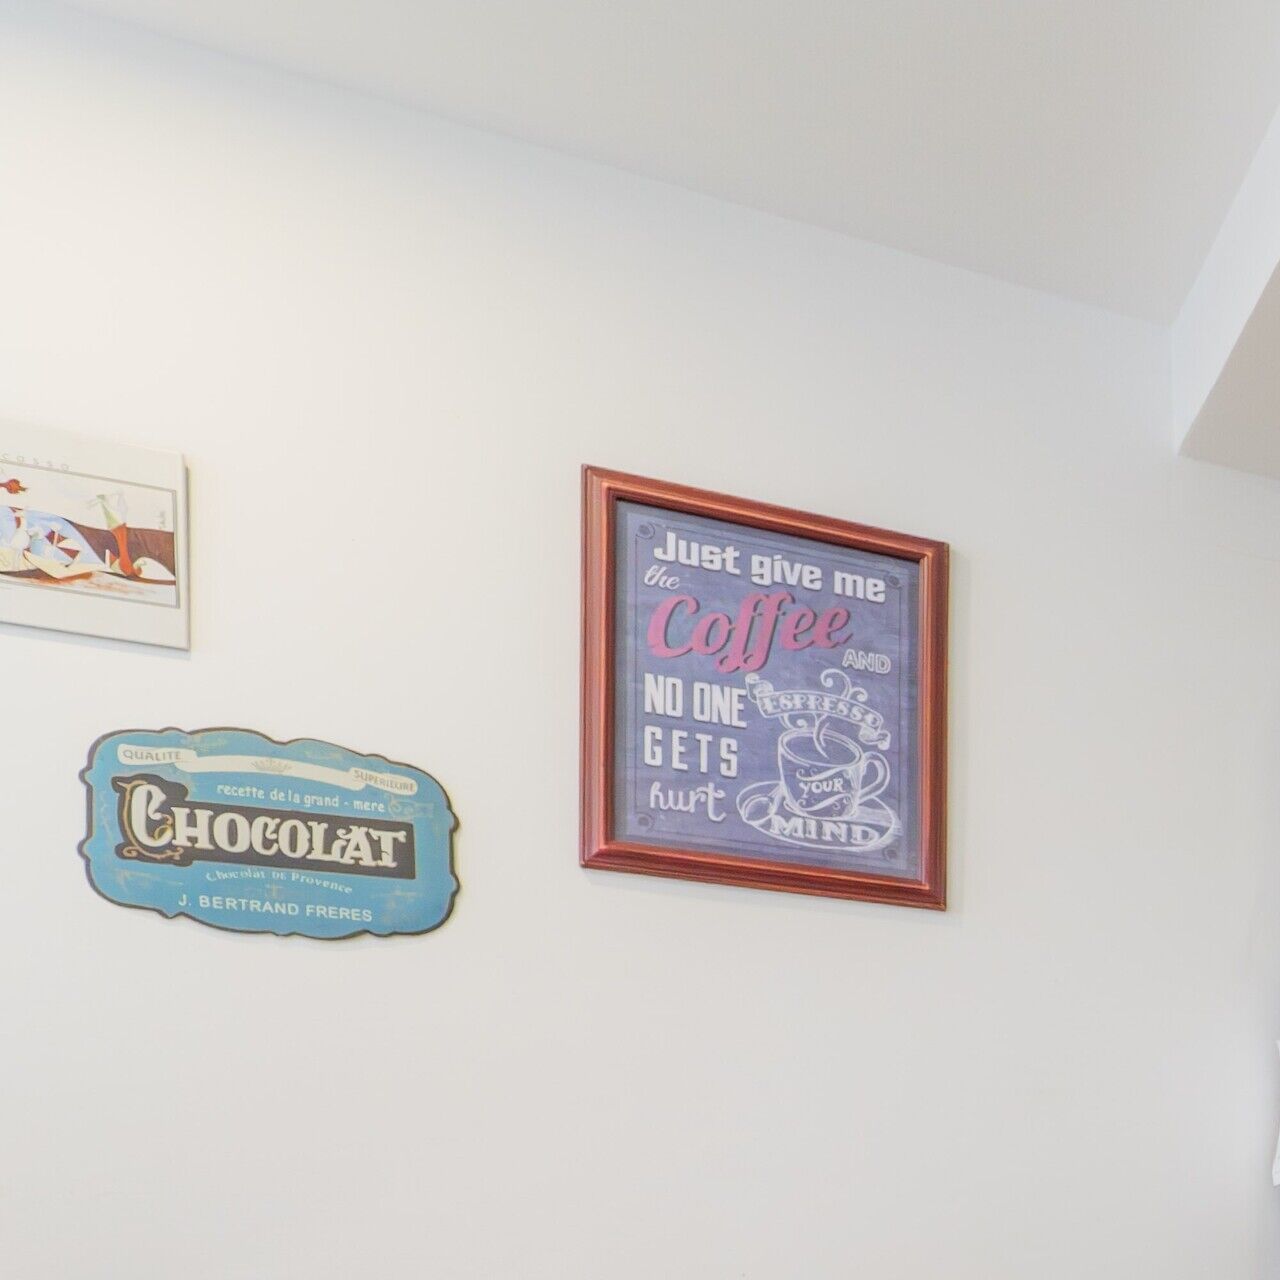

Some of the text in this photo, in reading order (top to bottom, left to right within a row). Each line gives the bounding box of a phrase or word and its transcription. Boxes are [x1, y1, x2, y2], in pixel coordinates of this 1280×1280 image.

[644, 565, 680, 591] the
[653, 530, 886, 603] Just give me
[647, 591, 853, 673] Coffee
[842, 648, 891, 674] AND
[643, 672, 748, 728] NO ONE
[762, 692, 881, 730] ESPRESSO
[122, 749, 181, 761] QUALITE
[643, 726, 739, 778] GETS
[216, 784, 265, 799] recette
[303, 793, 340, 808] grand
[353, 800, 386, 812] mere
[649, 780, 727, 822] hurt
[799, 777, 844, 798] YOUR
[130, 783, 407, 869] CHOCOLAT
[770, 815, 879, 844] MIND
[205, 869, 265, 882] Chocolat
[291, 870, 353, 894] Provence
[178, 893, 373, 922] J. BERTRAND FRERES
